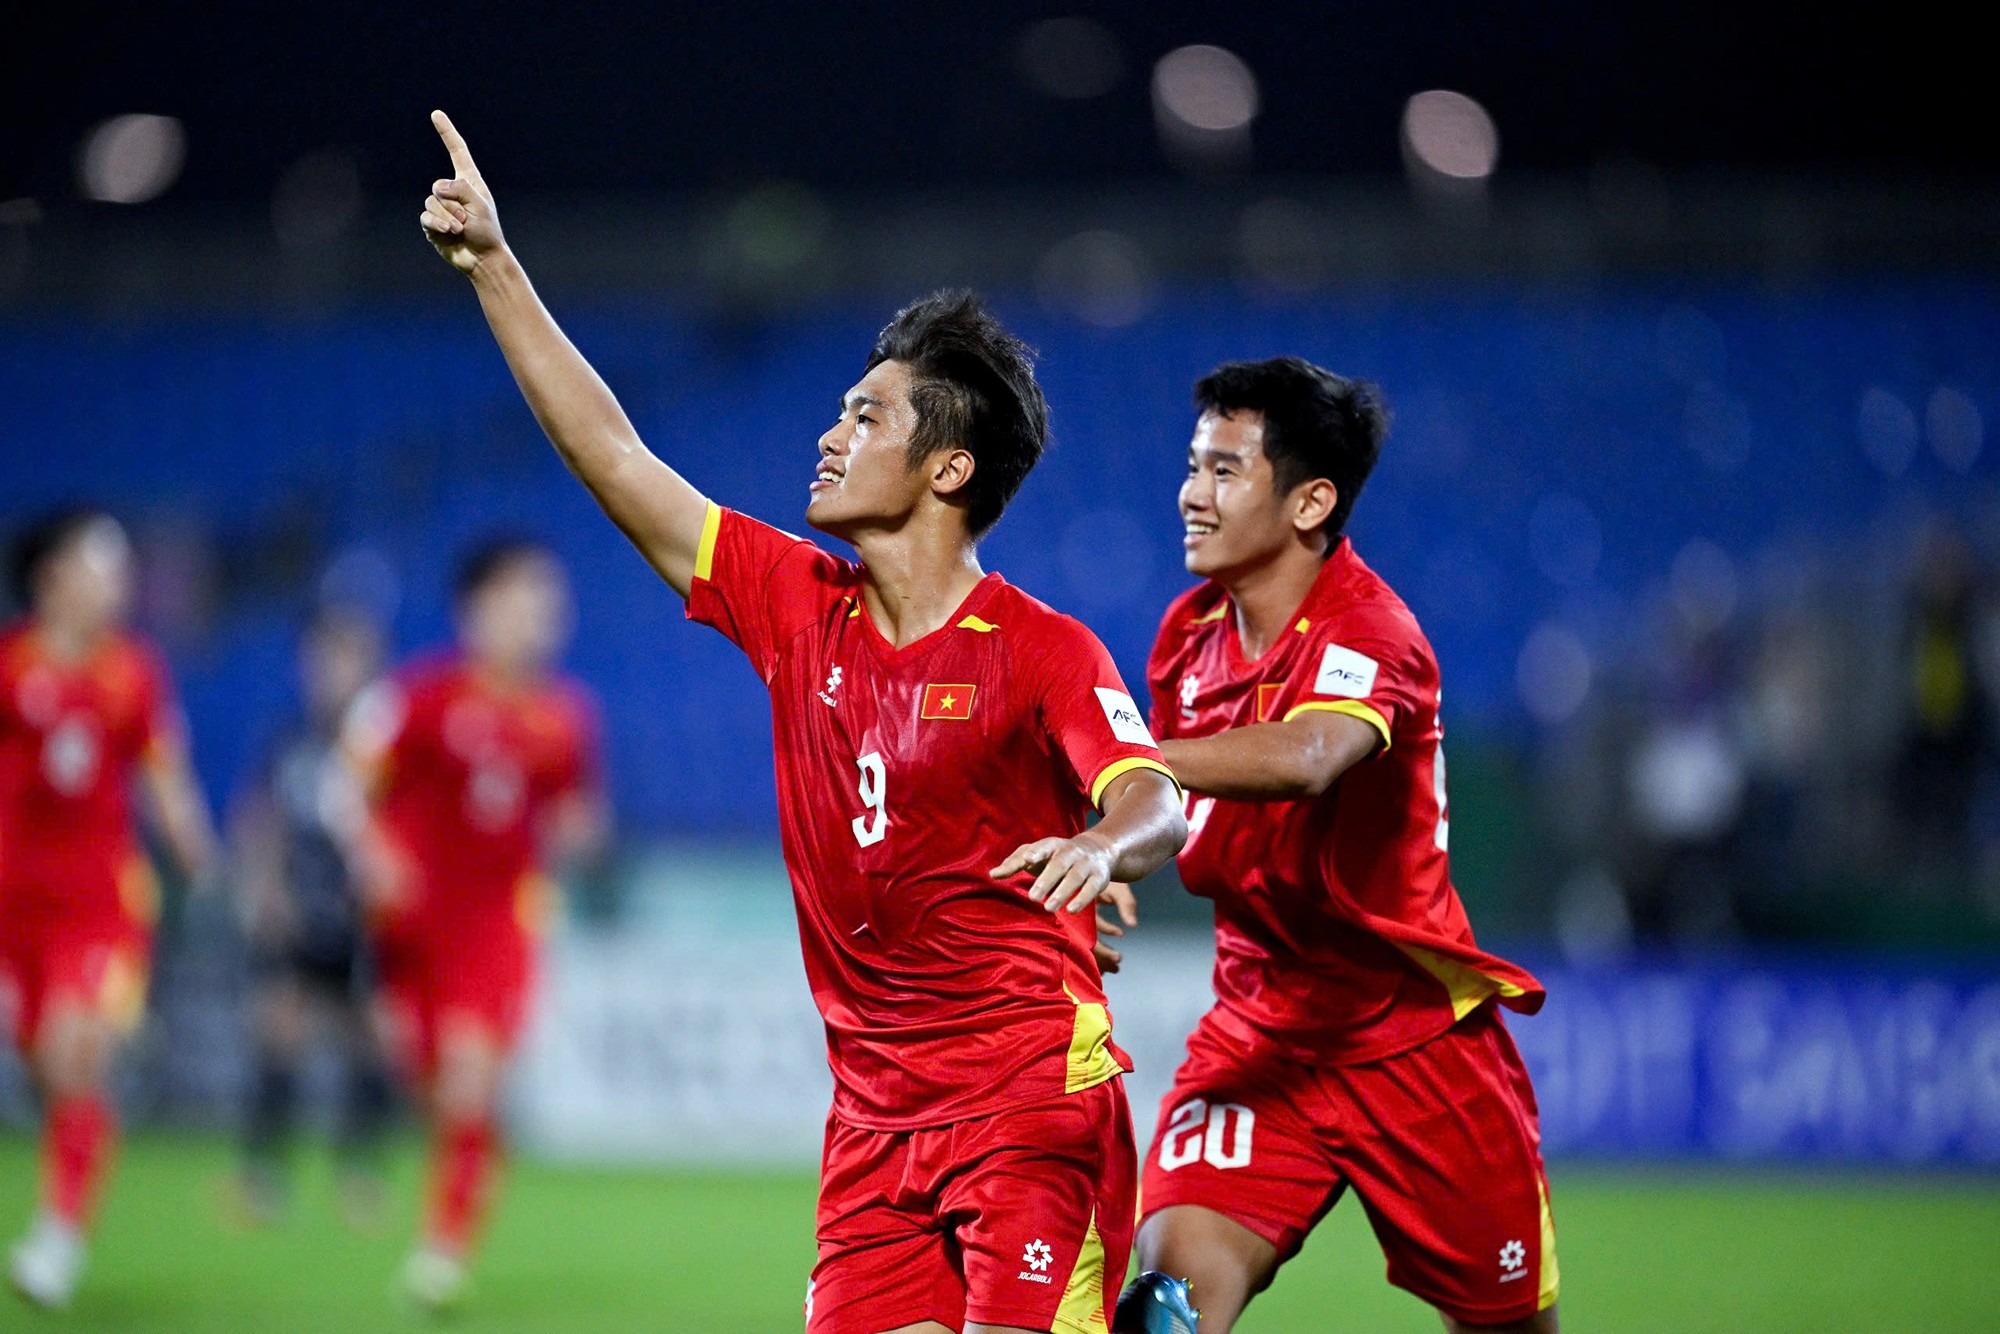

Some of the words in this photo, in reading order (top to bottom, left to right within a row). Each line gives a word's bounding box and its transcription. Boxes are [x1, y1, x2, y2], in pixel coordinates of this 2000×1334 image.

[1326, 669, 1365, 685] AFC
[1112, 709, 1141, 727] AFC
[852, 751, 887, 848] 9
[1158, 1098, 1255, 1172] 20
